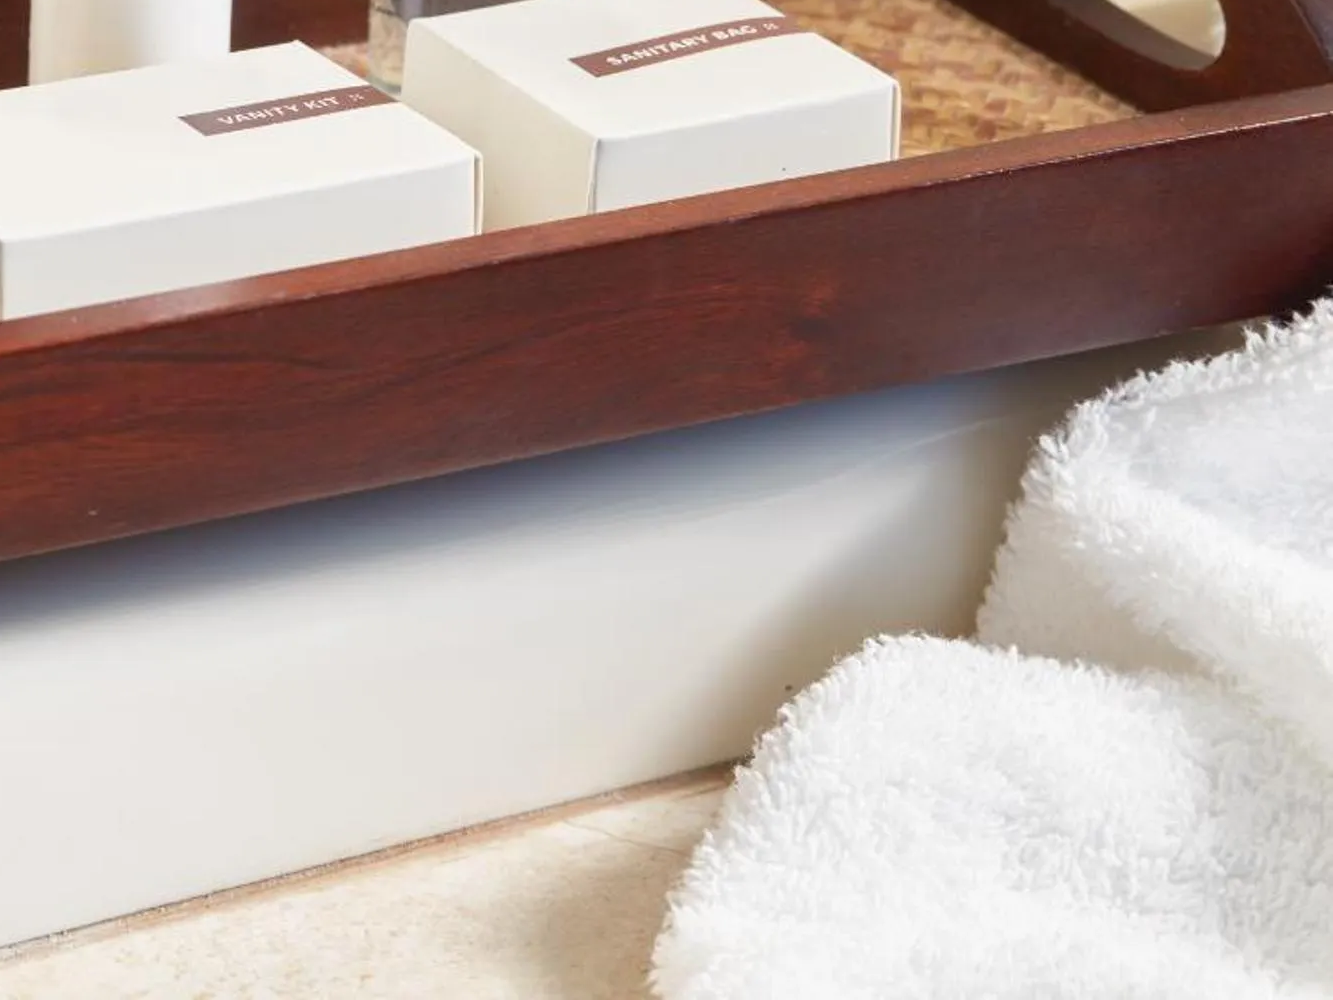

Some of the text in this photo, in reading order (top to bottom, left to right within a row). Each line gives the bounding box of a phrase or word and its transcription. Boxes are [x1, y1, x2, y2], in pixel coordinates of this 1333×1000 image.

[606, 24, 758, 66] SANITARY BAG
[216, 96, 340, 125] VANITY KIT
